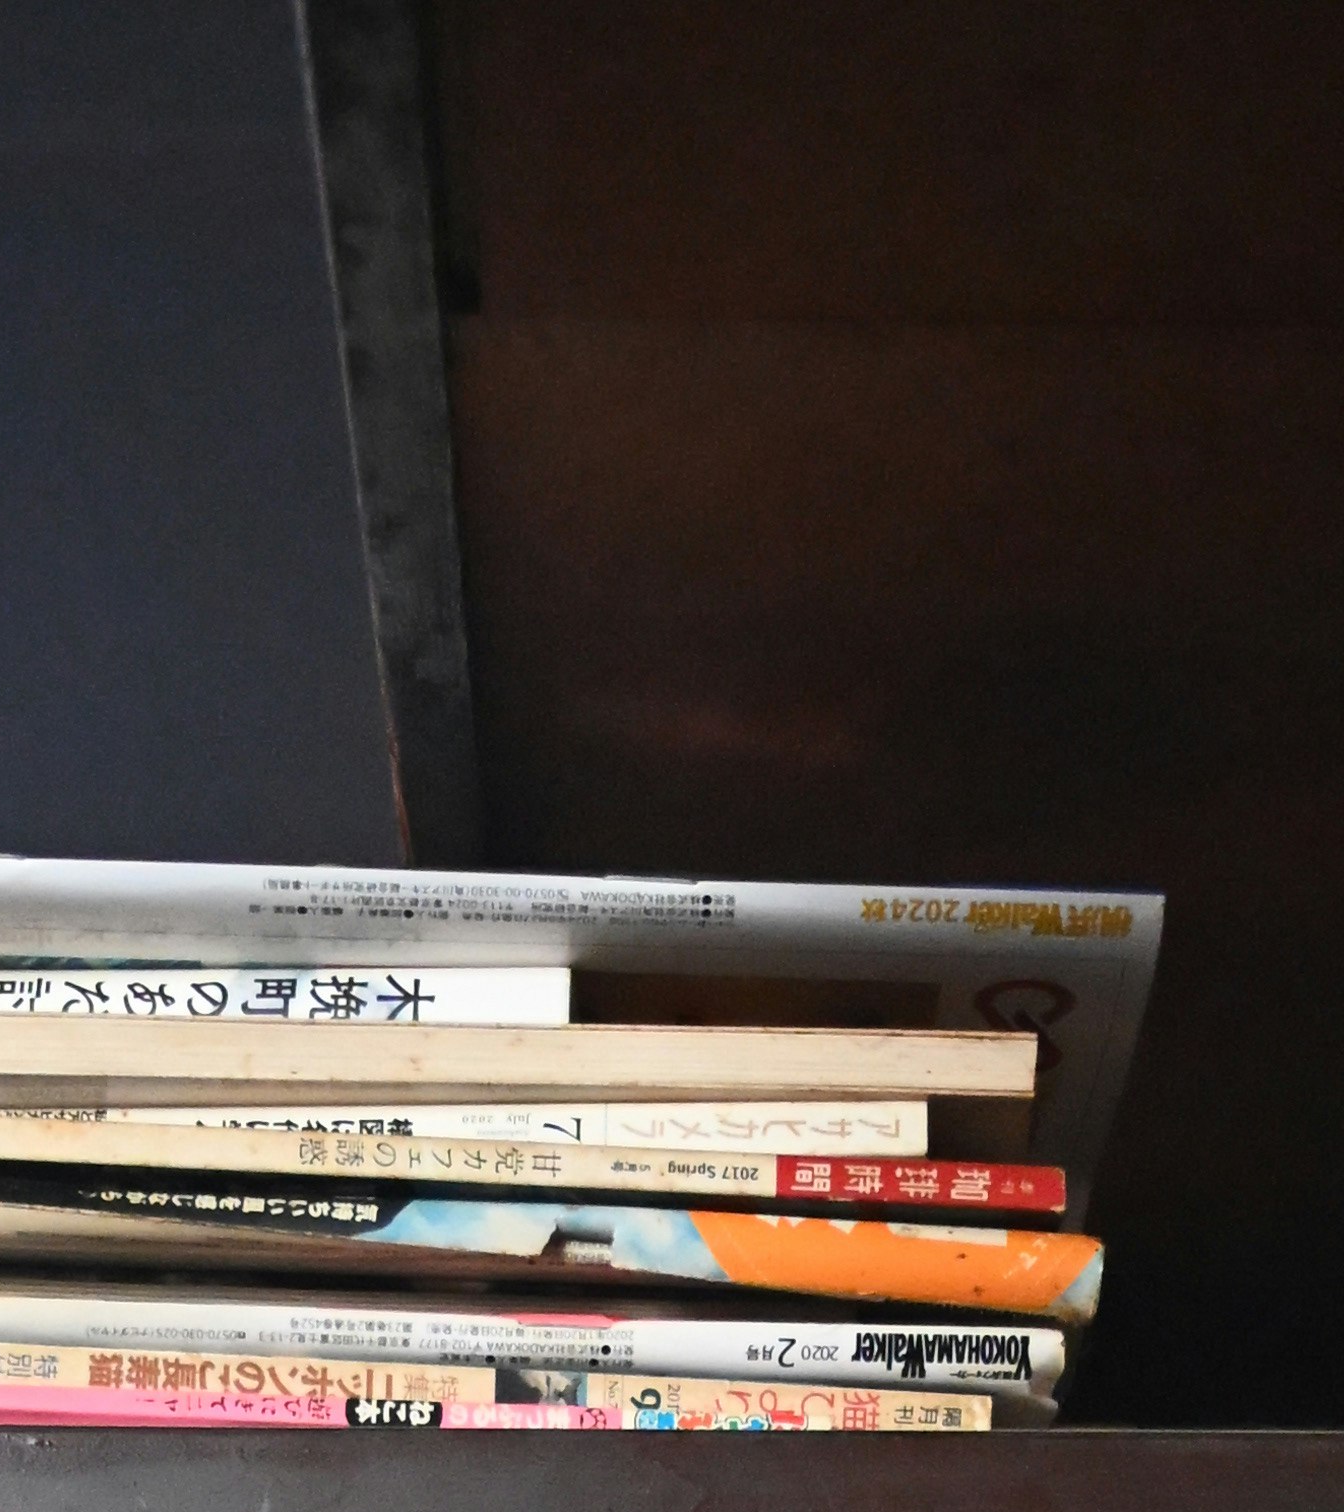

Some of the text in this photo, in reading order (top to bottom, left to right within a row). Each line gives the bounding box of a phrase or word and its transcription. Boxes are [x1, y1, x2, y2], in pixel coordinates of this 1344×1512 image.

[461, 1113, 531, 1125] July 2020
[616, 1115, 900, 1141] アサヒカメラ
[298, 1138, 563, 1181] 甘党カフェの誘惑
[668, 1159, 717, 1181] Spring
[722, 1163, 760, 1183] 2017
[790, 1163, 992, 1202] 珈琲時間
[800, 1343, 840, 1363] 2020
[893, 1406, 962, 1428] 隔月刊
